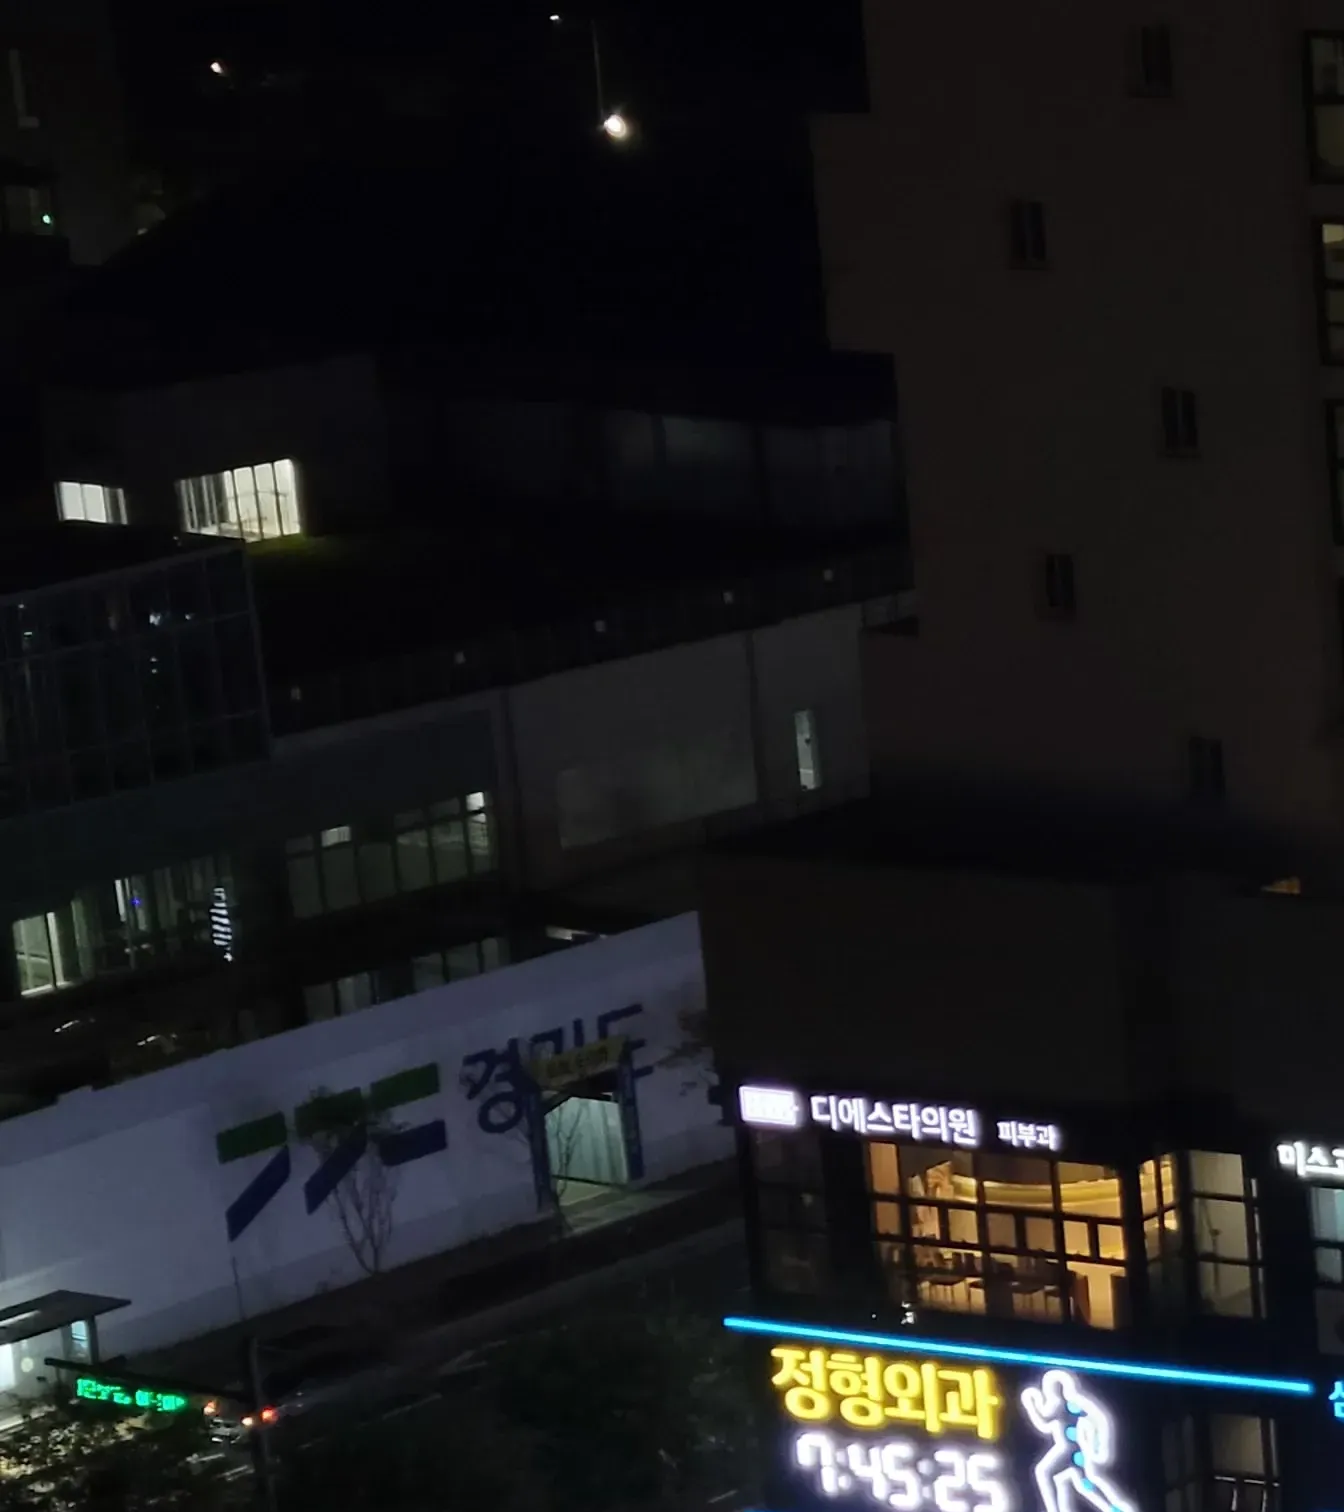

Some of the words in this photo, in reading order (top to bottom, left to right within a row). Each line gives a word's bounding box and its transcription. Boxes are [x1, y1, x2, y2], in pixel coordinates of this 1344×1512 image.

[810, 1096, 978, 1145] 디에스타의원
[997, 1121, 1060, 1150] 피부과
[771, 1346, 1001, 1438] 정형외과
